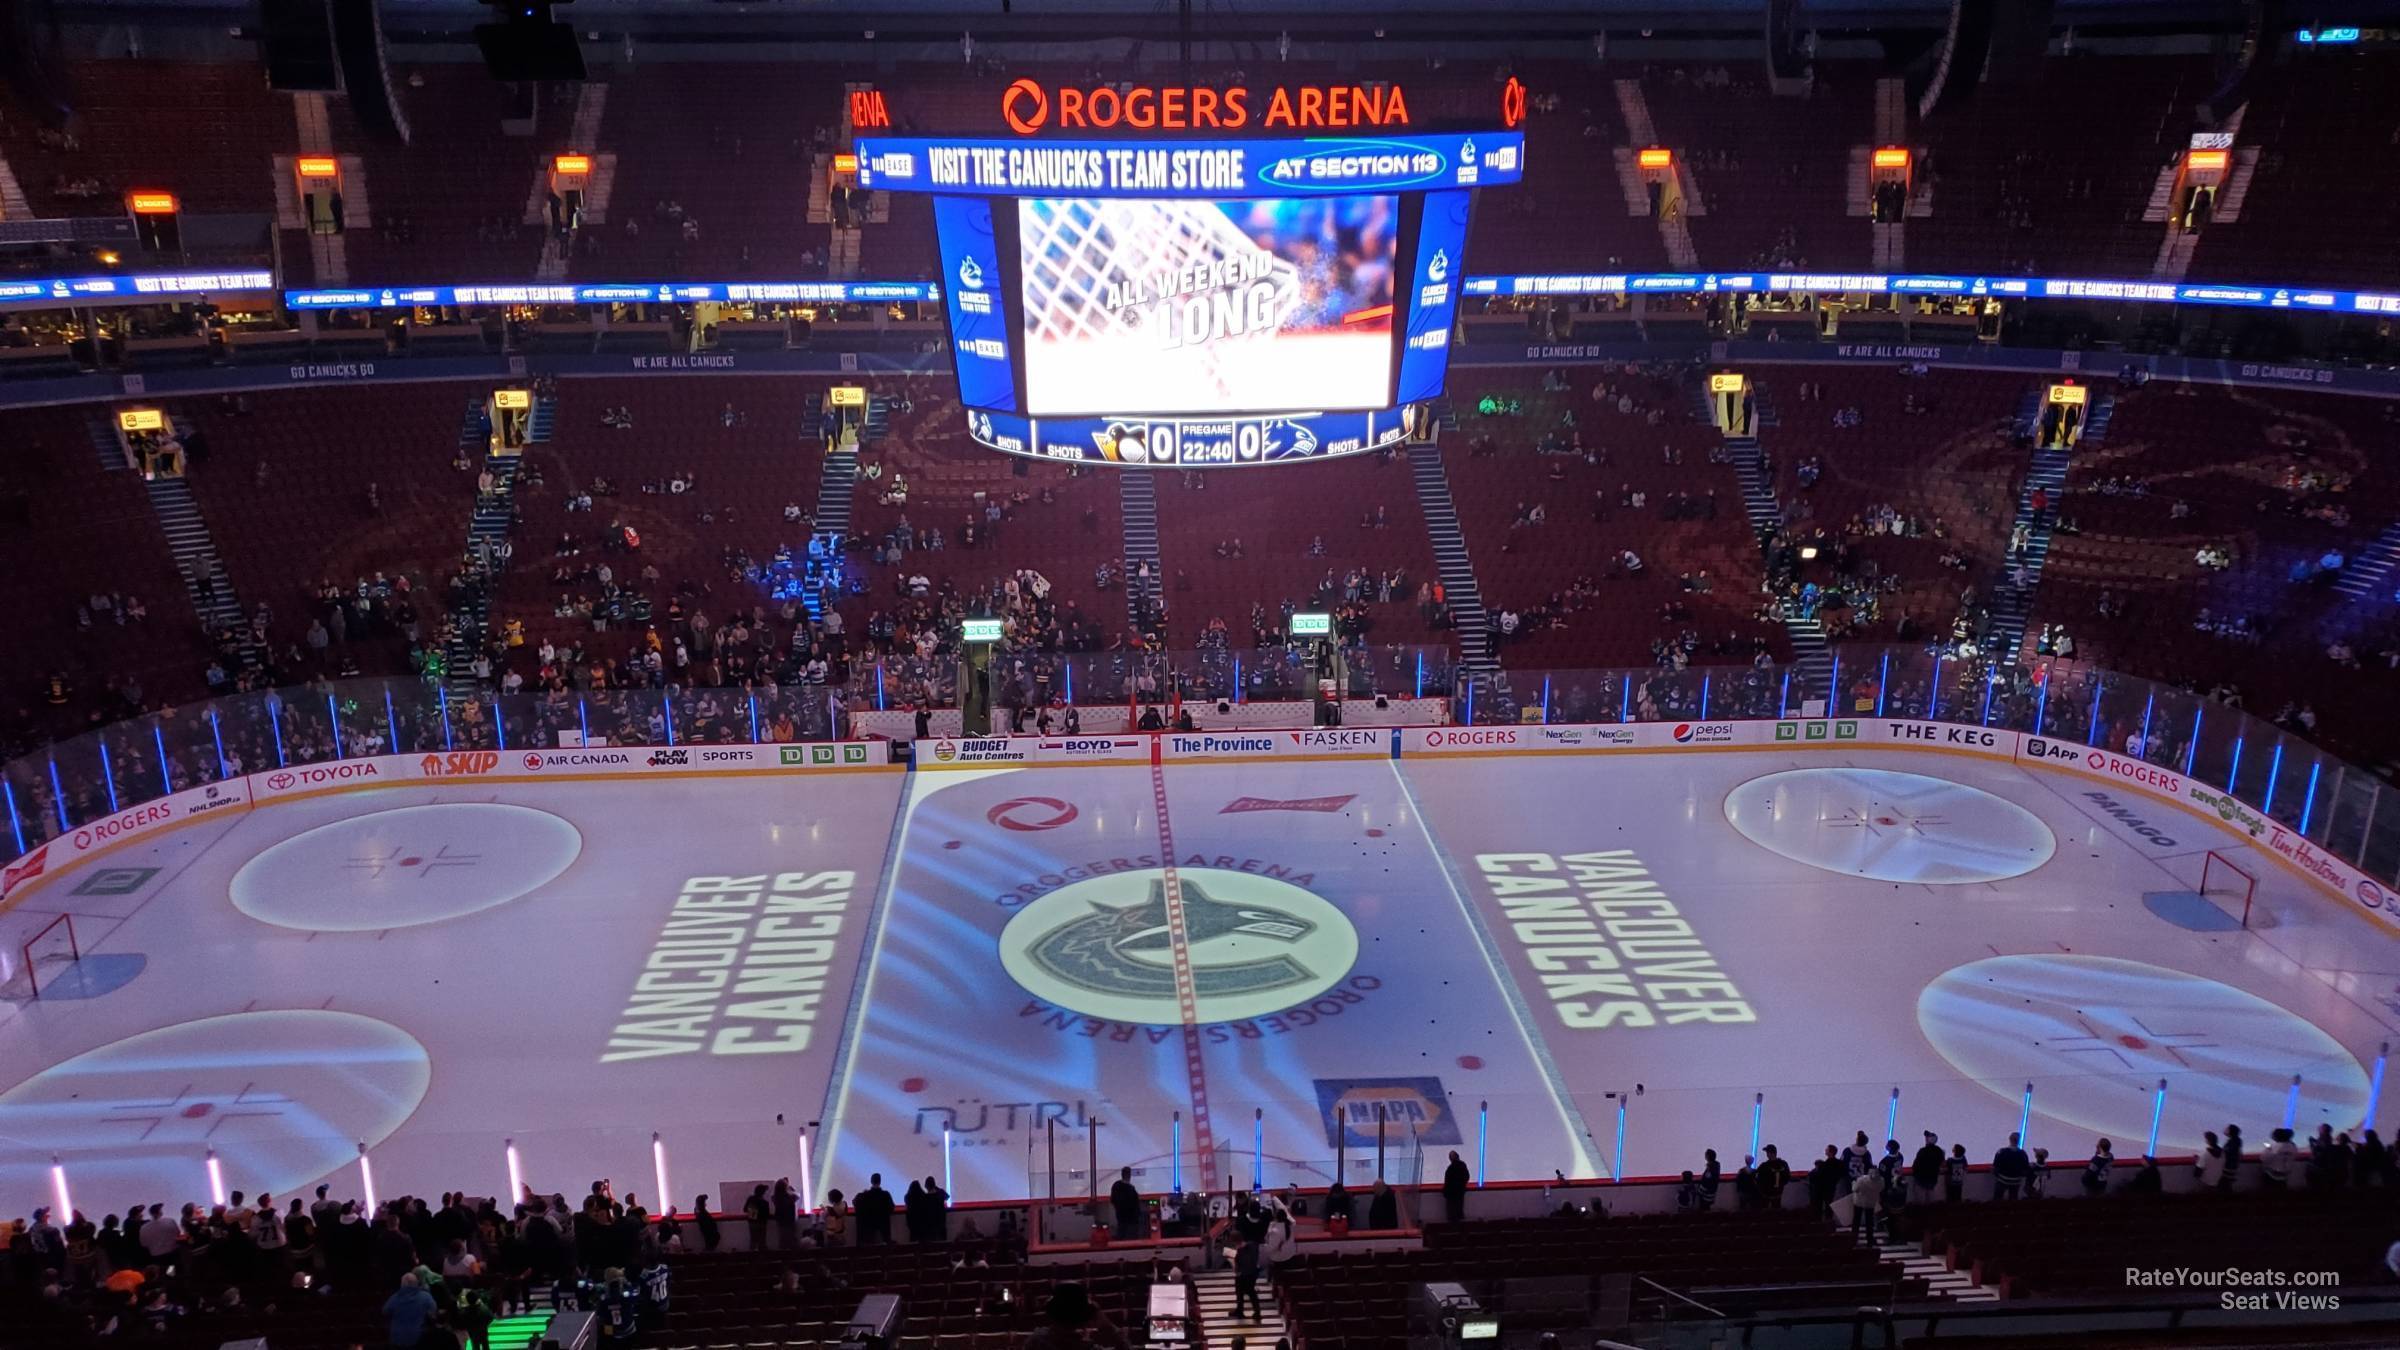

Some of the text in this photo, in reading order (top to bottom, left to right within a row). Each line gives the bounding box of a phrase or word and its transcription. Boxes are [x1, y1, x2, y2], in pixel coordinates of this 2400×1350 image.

[1060, 86, 1409, 129] ROGERS ARENA
[928, 147, 1246, 188] VISIT THE CANUCKS TEAM STORE
[1273, 153, 1438, 179] AT SECTION 113
[219, 275, 243, 289] TEAM
[1106, 251, 1273, 310] ALL WEEKEND
[1841, 276, 1863, 289] TEAM
[527, 288, 549, 302] TEAM
[2124, 285, 2146, 297] TEAM
[1158, 282, 1275, 351] LONG
[977, 342, 1001, 355] BASE
[1527, 345, 1599, 358] GO CANUCKS GO
[1838, 345, 1940, 359] WE ARE ALL CANUCKS
[632, 355, 735, 369] WE ARE ALL CANUCKS
[290, 363, 375, 379] GO CANUCKS GO
[2242, 365, 2334, 383] GO CANUCKS GO
[1182, 424, 1232, 435] PREGAME
[1379, 427, 1400, 444] SHOTS
[996, 435, 1022, 451] SHOTS
[1152, 425, 1174, 461] 0
[1239, 424, 1259, 459] 0
[1327, 438, 1359, 454] SHOTS
[1047, 445, 1083, 459] SHOTS
[1182, 441, 1232, 461] 22:40
[1304, 731, 1376, 745] FASKEN
[1447, 730, 1516, 745] ROGERS
[1546, 729, 1582, 739] NexGen
[1598, 729, 1634, 739] NexGen
[1696, 723, 1733, 737] pepsi
[1889, 723, 1995, 746] THE KEG
[961, 740, 1008, 752] BUDGET
[1065, 740, 1112, 750] BOYD
[1172, 736, 1273, 752] The Province
[546, 754, 629, 766] AIR CANADA
[654, 750, 687, 758] PLAY
[655, 757, 688, 765] NOW
[702, 751, 753, 761] SPORTS
[960, 751, 1024, 761] Auto Centres
[445, 752, 498, 775] SKIP
[299, 763, 378, 785] TOYOTA
[2110, 759, 2179, 792] ROGERS
[2082, 792, 2178, 847] PANAGO
[2191, 788, 2266, 836] save on foods
[95, 803, 171, 841] ROGERS
[2270, 825, 2348, 889] Tim Hortons
[1016, 853, 1316, 895] ROGERS ARENA
[1475, 852, 1656, 1028] CANUCKS
[1560, 849, 1757, 1025] VANCOUVER
[598, 873, 769, 1064] VANCOUVER
[711, 870, 856, 1055] CANUCKS
[1019, 987, 1366, 1045] ROGERS ARENA
[1347, 1100, 1427, 1123] NAPA
